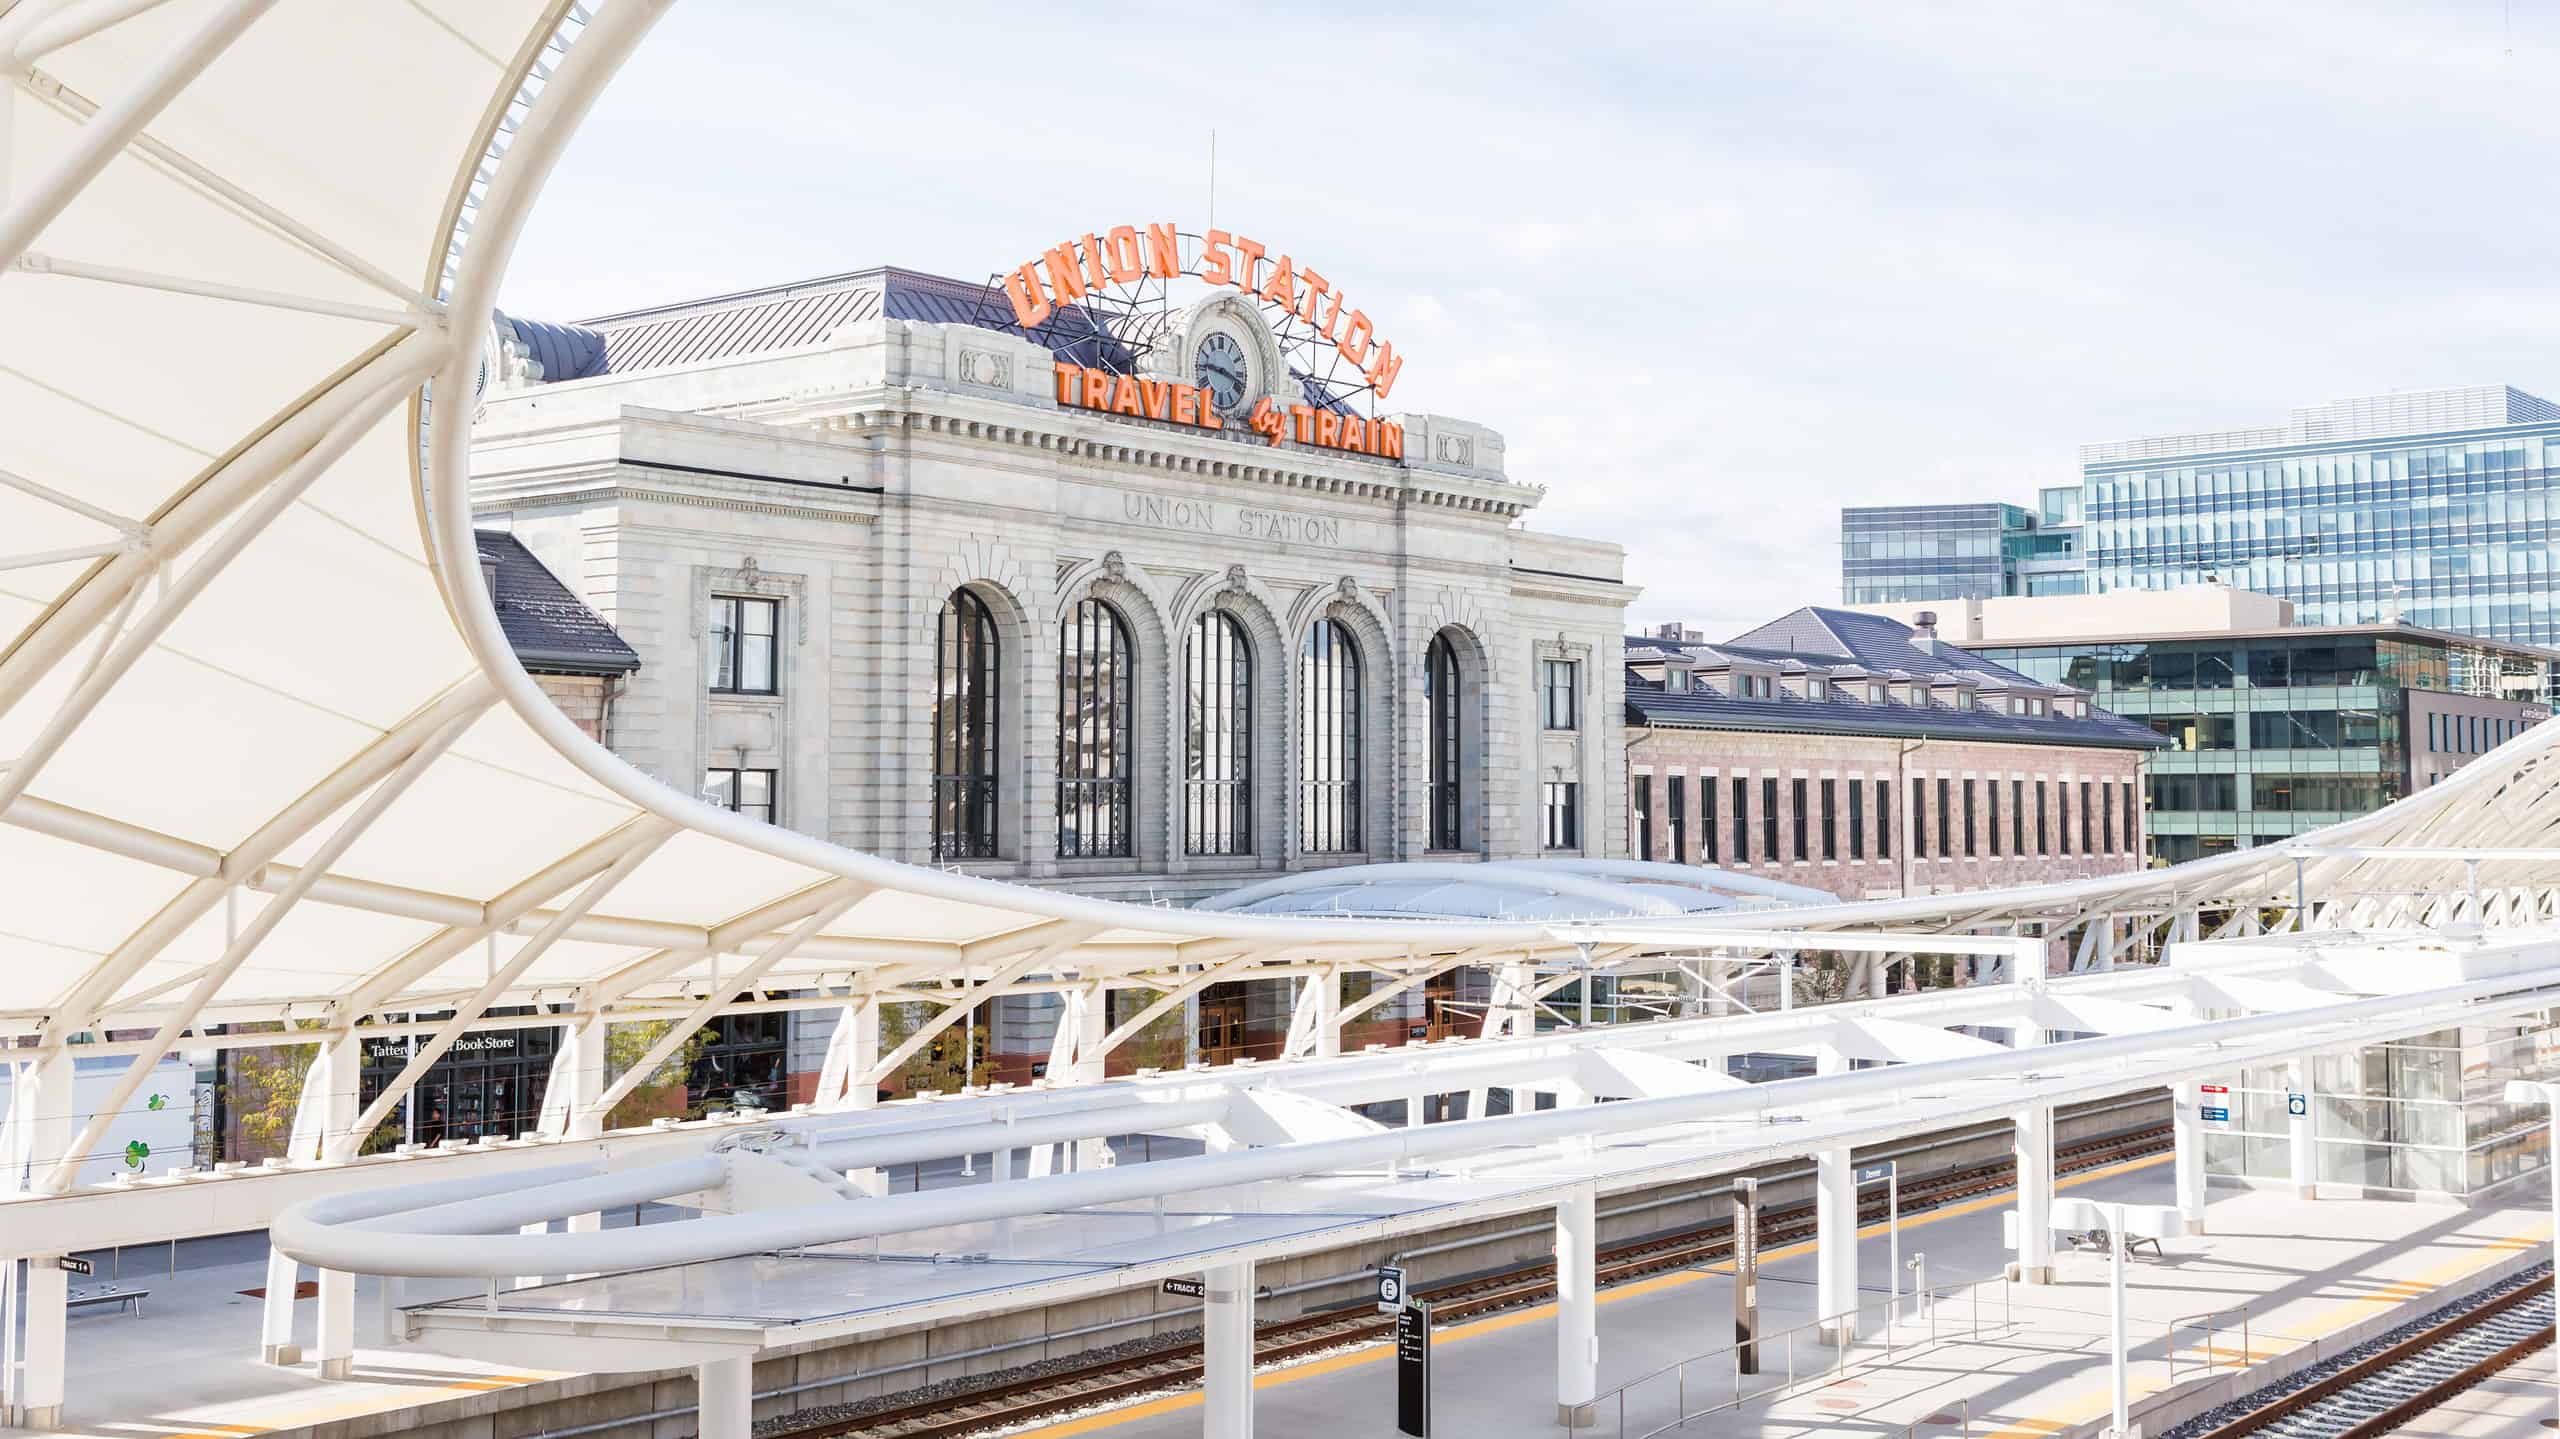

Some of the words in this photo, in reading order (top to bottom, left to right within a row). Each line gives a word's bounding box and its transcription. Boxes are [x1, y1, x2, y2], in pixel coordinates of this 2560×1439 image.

[1004, 222, 1181, 328] UNION
[1200, 228, 1403, 400] STATION
[1055, 361, 1222, 430] TRAVEL
[1249, 396, 1288, 448] by
[1290, 404, 1404, 460] TRAIN
[1123, 494, 1213, 530] UNION
[1239, 509, 1339, 545] STATION
[456, 1039, 485, 1051] Book
[485, 1037, 515, 1049] Store
[1173, 1283, 1196, 1293] TRACK
[1198, 1286, 1204, 1295] 2
